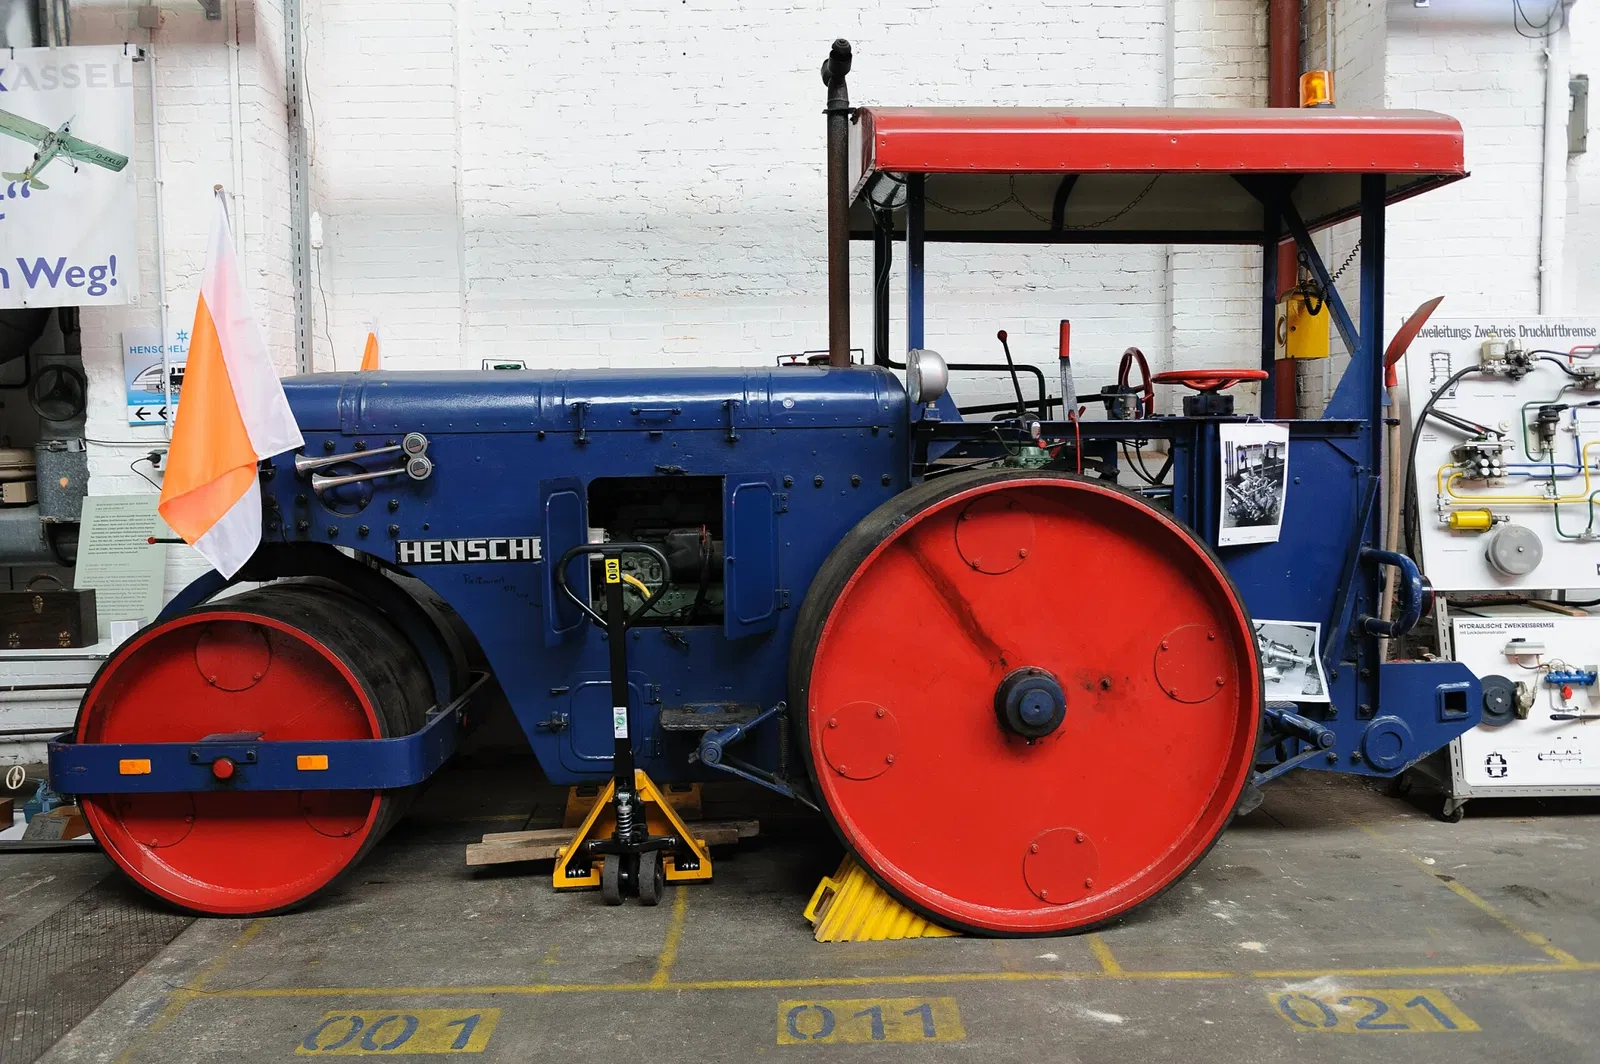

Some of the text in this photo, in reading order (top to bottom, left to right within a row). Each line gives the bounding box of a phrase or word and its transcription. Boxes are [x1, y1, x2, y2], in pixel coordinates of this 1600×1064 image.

[16, 254, 118, 297] Weg!
[1474, 325, 1516, 338] Zweikreis
[1519, 324, 1597, 338] Druckluftbremse
[785, 1003, 937, 1041] 011
[1277, 993, 1459, 1030] 021
[302, 1013, 484, 1053] 001
